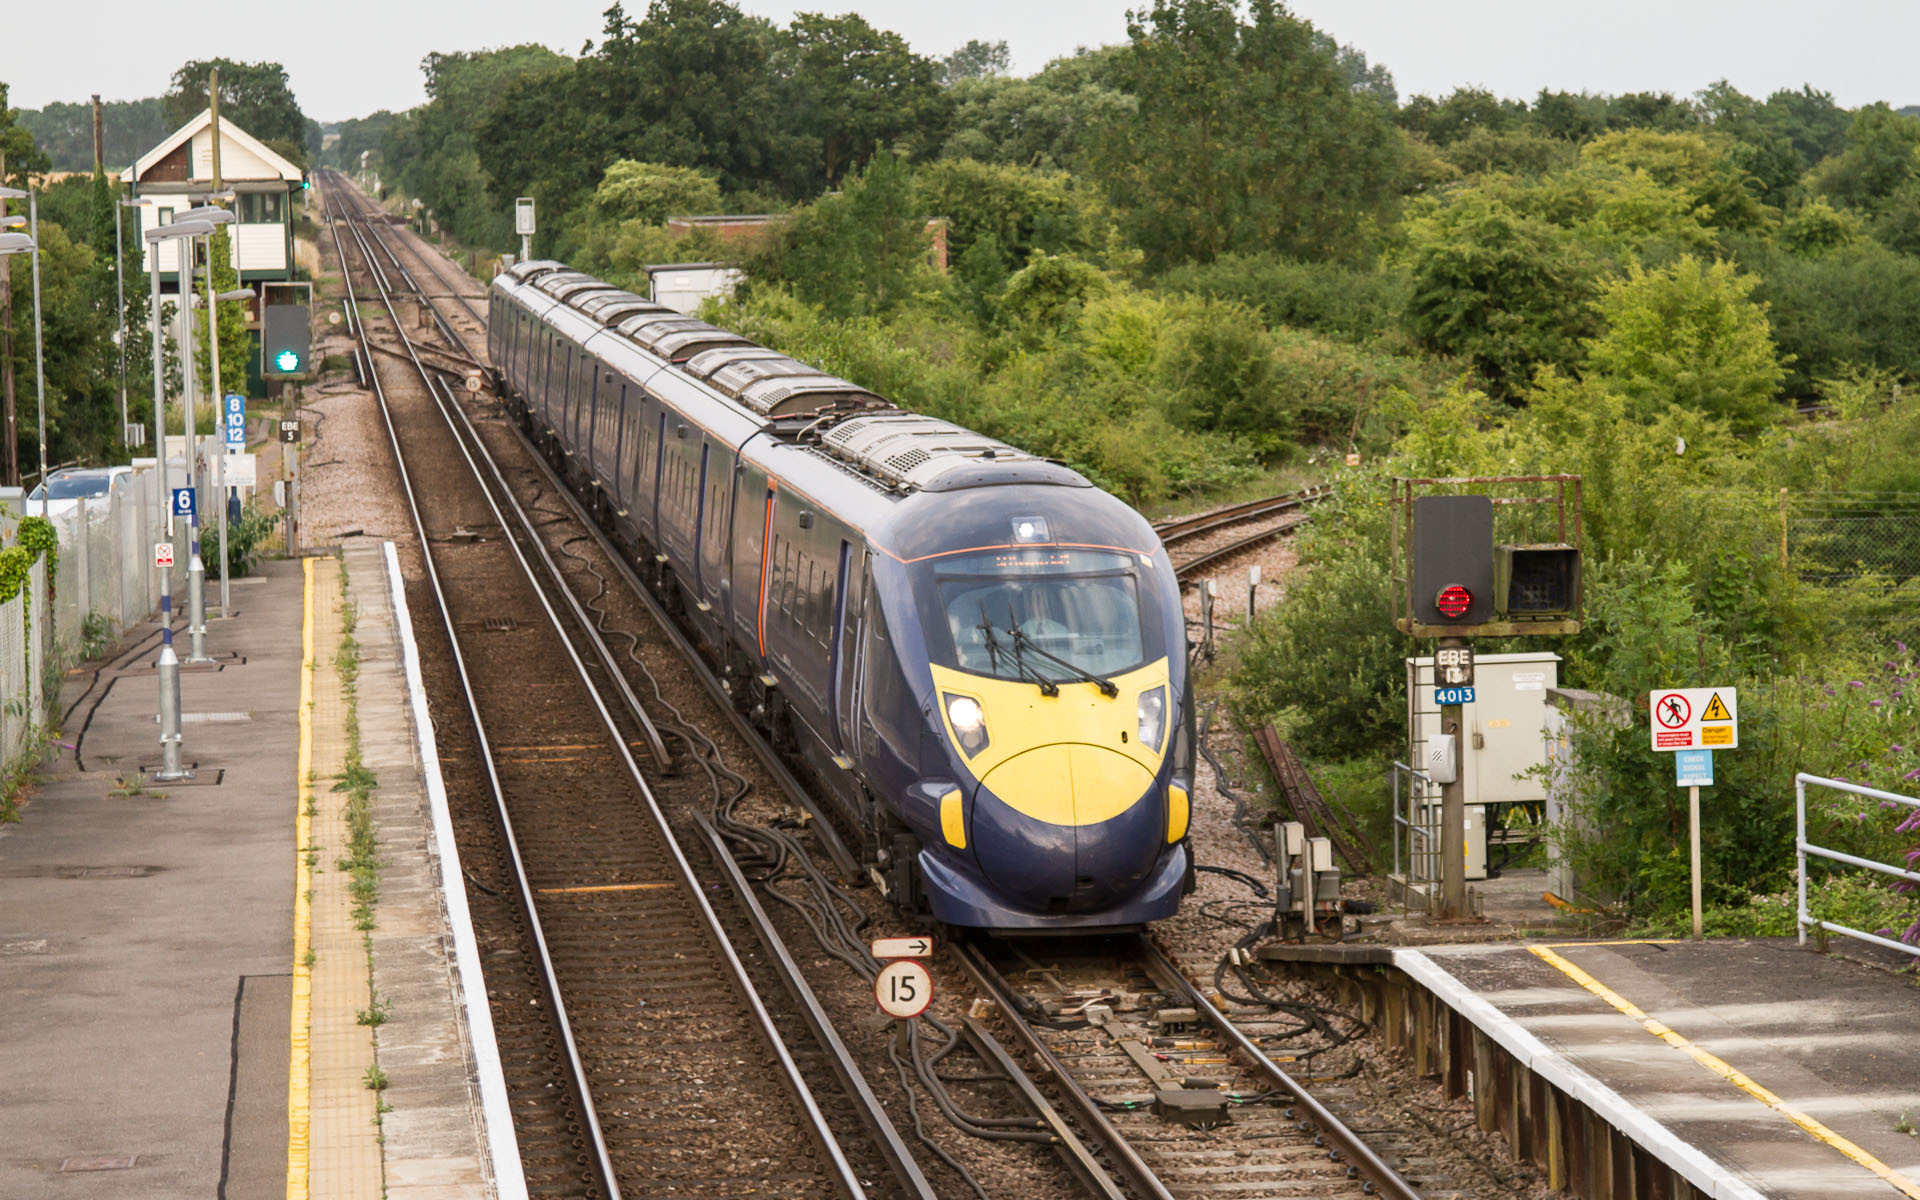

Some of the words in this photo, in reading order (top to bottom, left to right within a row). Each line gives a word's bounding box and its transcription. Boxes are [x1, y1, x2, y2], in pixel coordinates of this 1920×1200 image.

[230, 398, 240, 412] 8
[227, 413, 243, 426] 10
[281, 421, 299, 431] EBE
[228, 428, 243, 441] 12
[178, 490, 191, 509] 6
[1438, 650, 1470, 665] EBE
[1437, 689, 1473, 703] 4013
[891, 975, 916, 1003] 15
